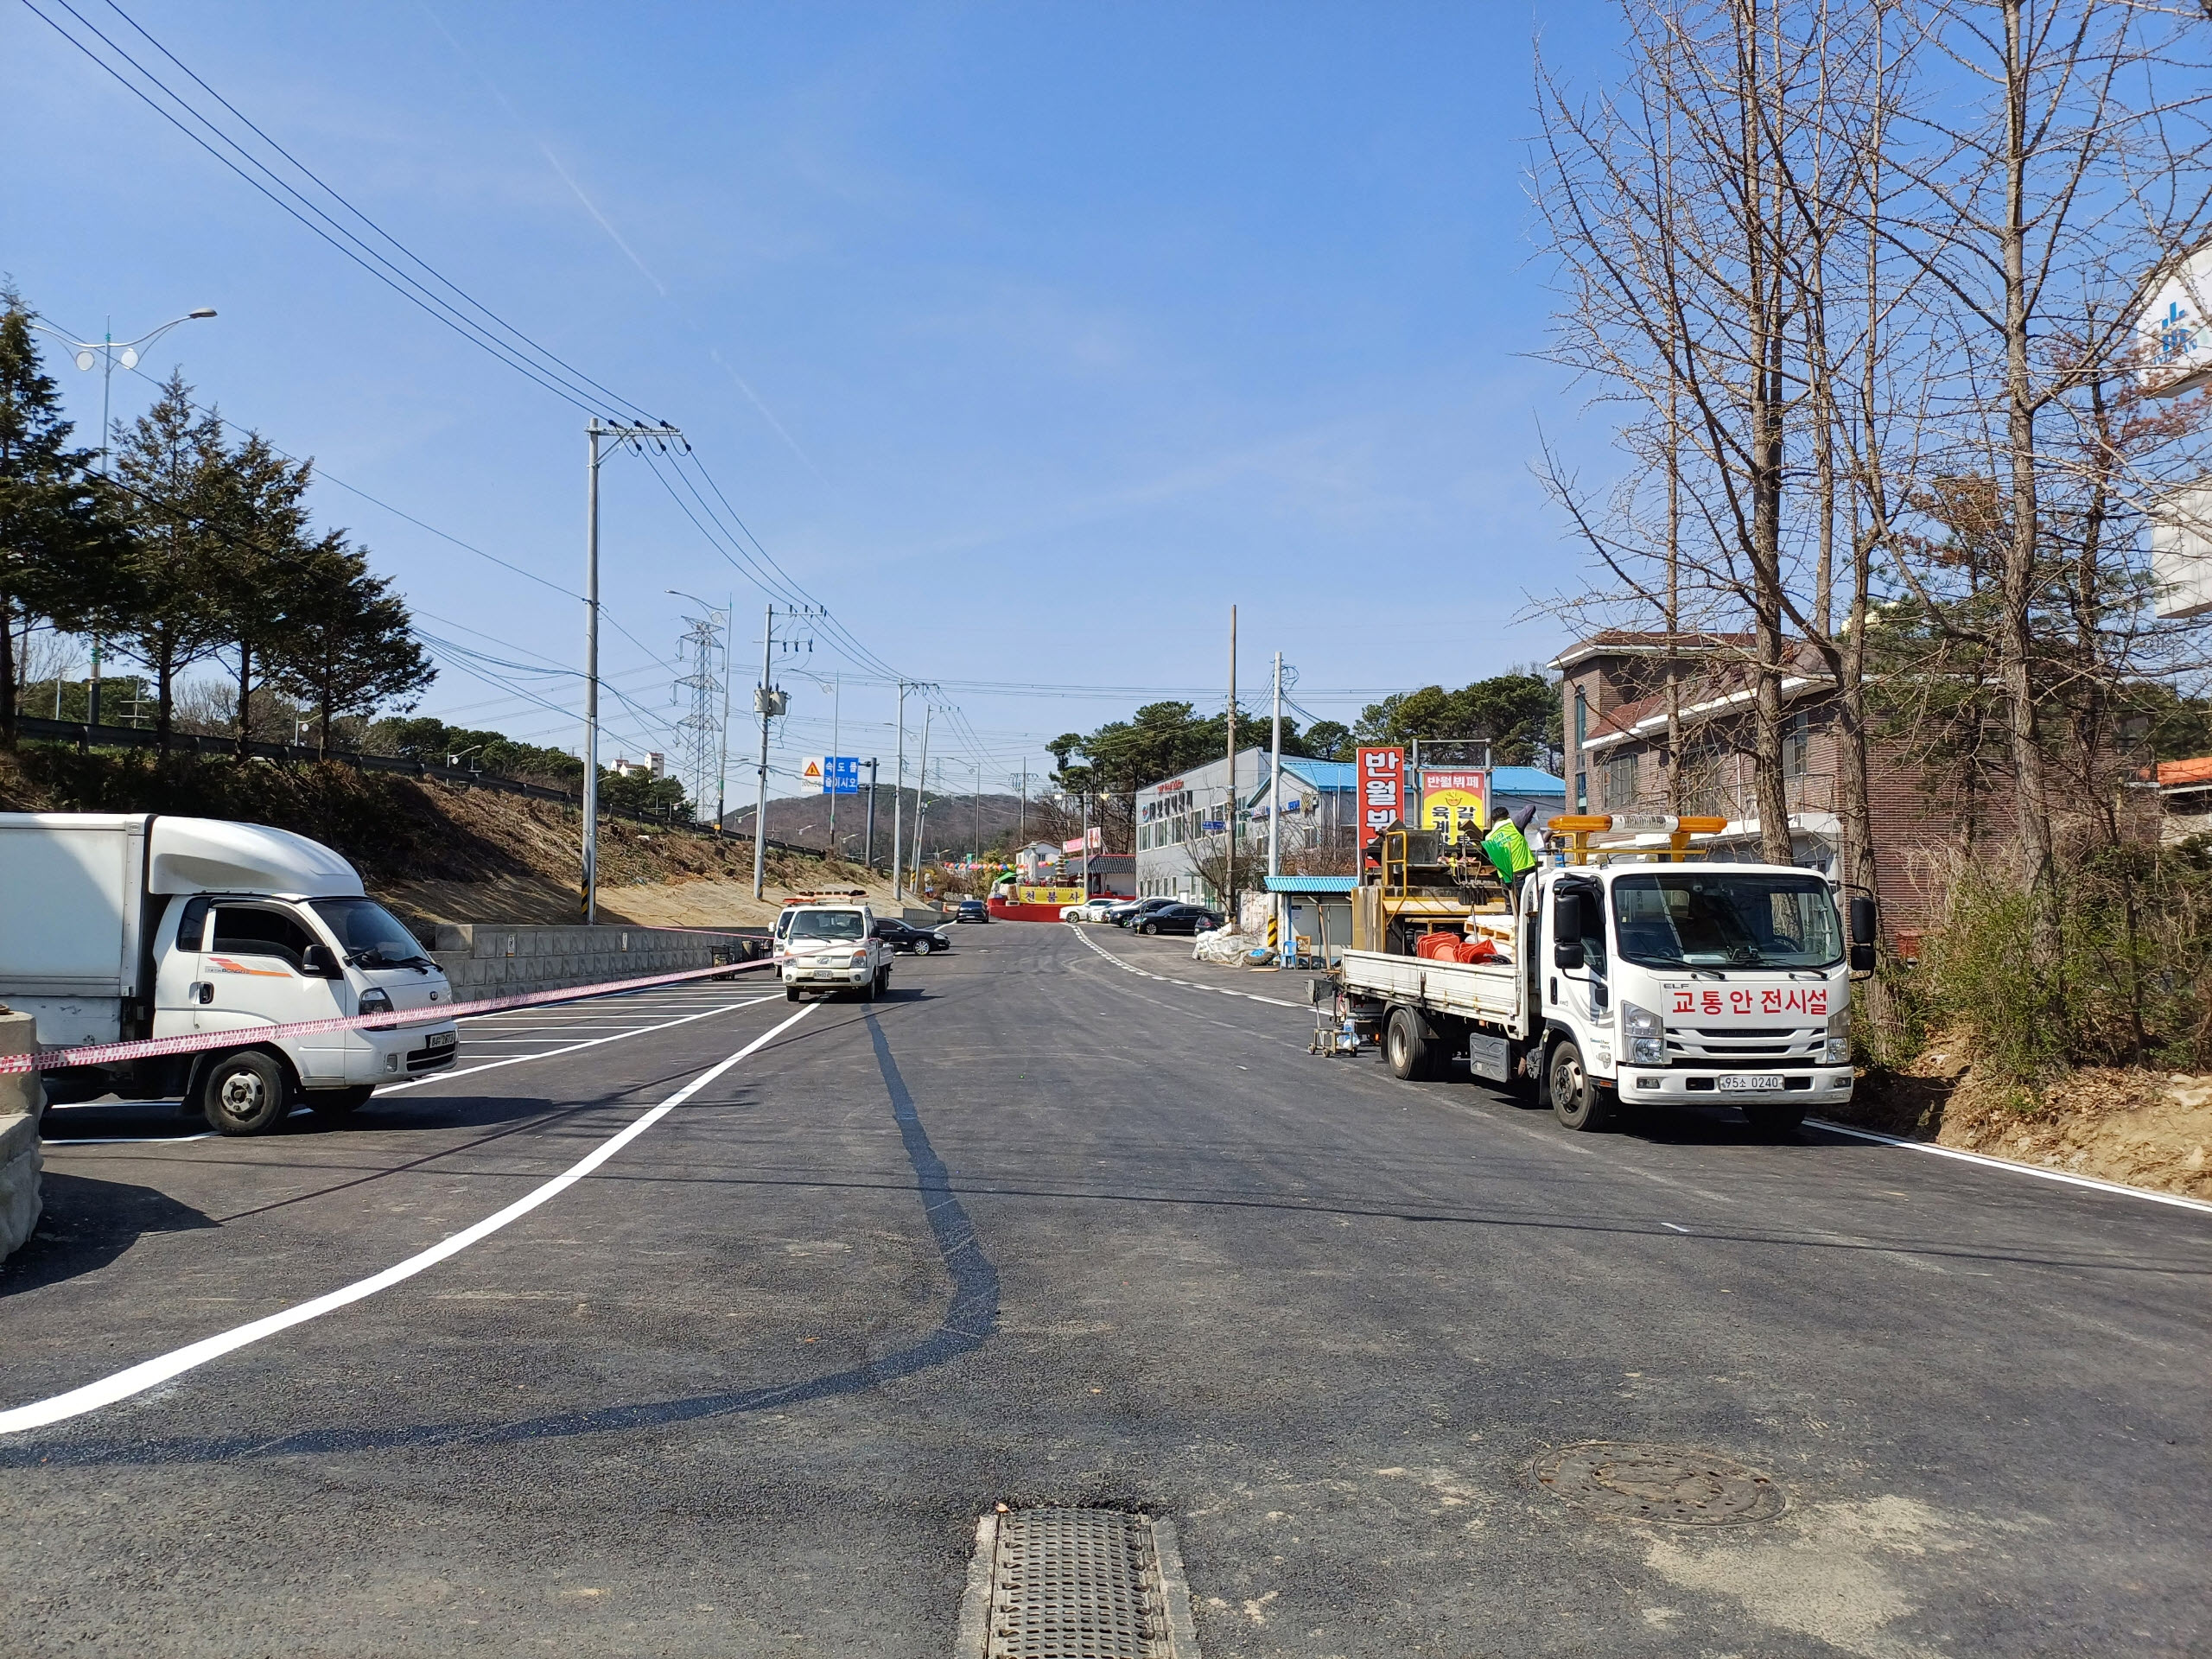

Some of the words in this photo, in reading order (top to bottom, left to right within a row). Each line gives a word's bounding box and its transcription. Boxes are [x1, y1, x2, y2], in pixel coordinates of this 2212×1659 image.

[1427, 775, 1479, 788] 반월뷔페
[1725, 1077, 1746, 1089] 95소
[1751, 1077, 1778, 1089] 0240
